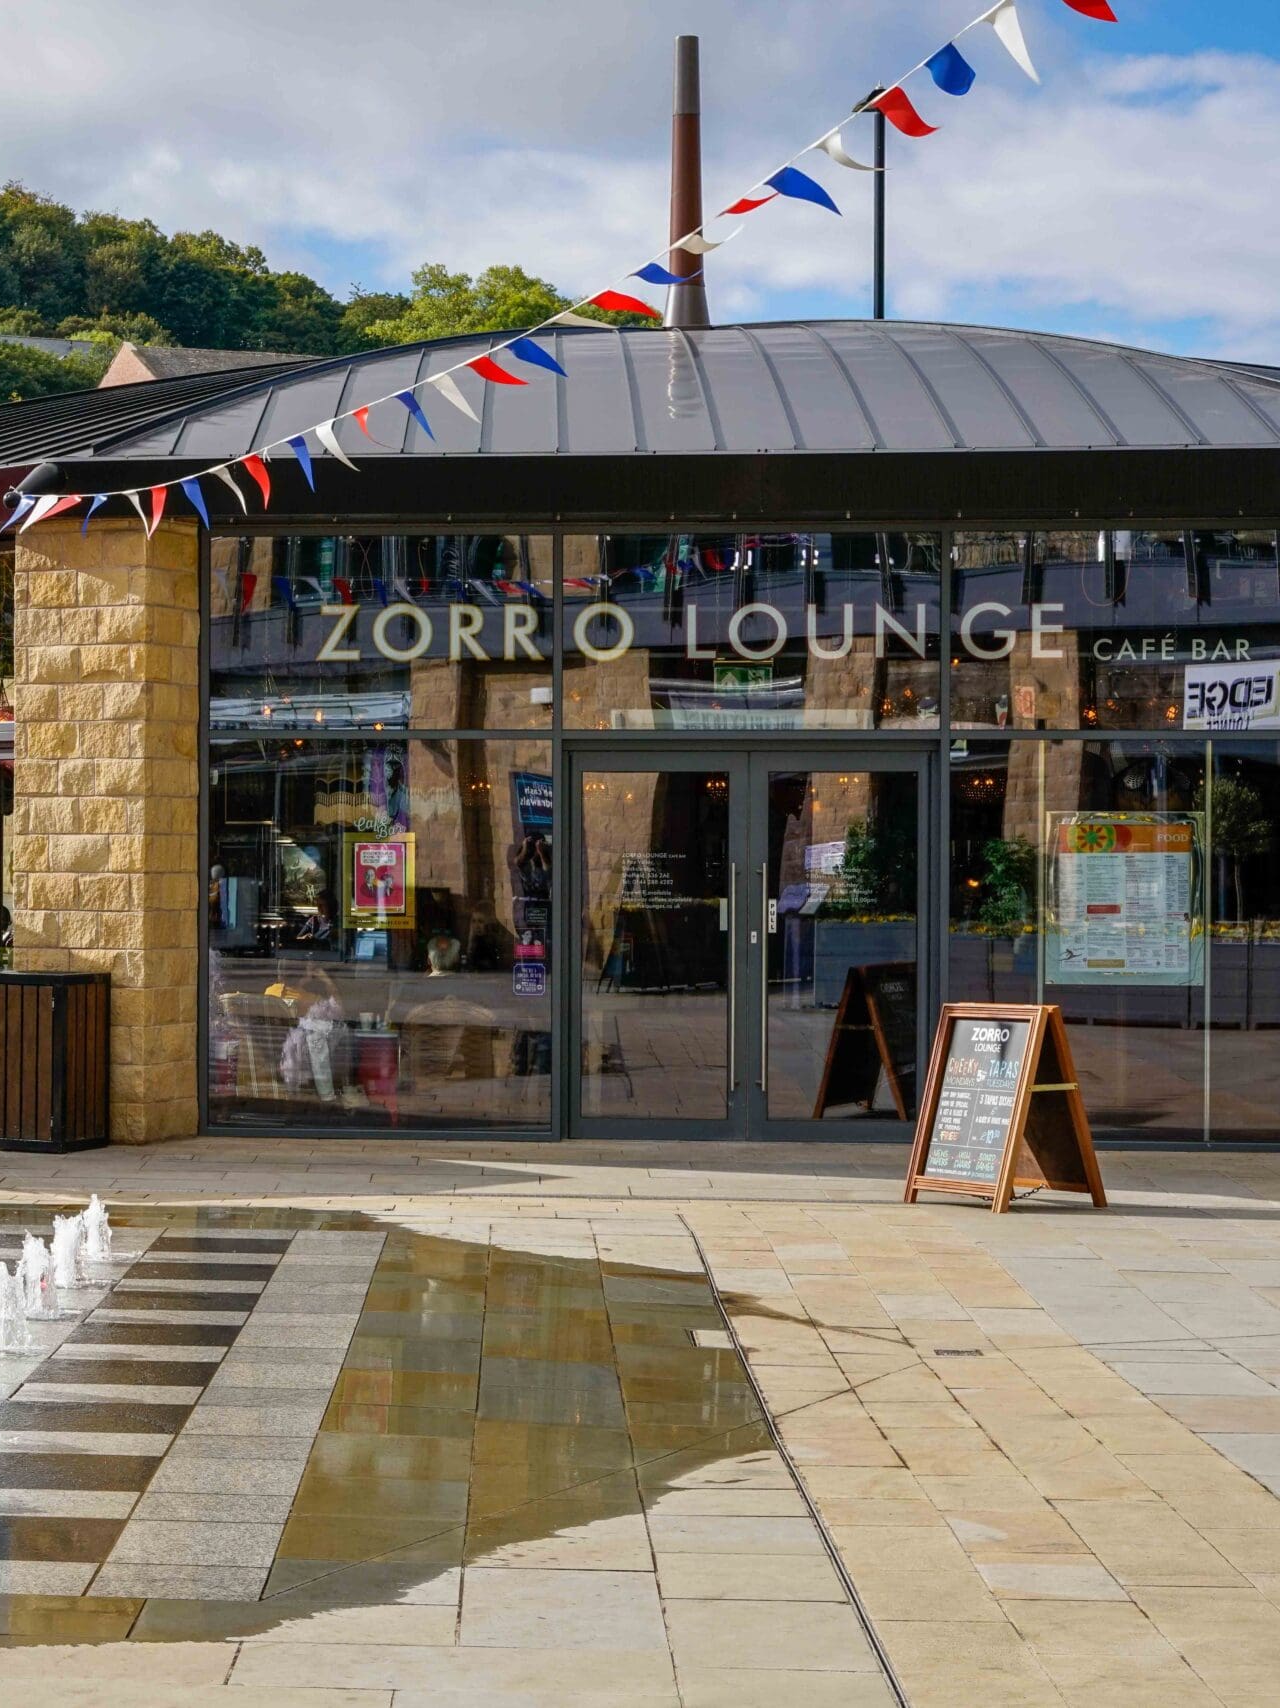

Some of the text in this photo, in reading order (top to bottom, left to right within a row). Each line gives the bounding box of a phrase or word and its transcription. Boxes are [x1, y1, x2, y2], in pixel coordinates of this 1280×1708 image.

[315, 601, 1252, 663] ZORRO LOUNGE CAFÉ BAR
[1156, 832, 1190, 843] FOOD
[971, 1027, 1010, 1042] ZORRO
[974, 1043, 1002, 1053] LOUNGE
[948, 1057, 979, 1077] CHEEKY
[989, 1059, 1019, 1079] TAPAS
[940, 1130, 960, 1141] FREE
